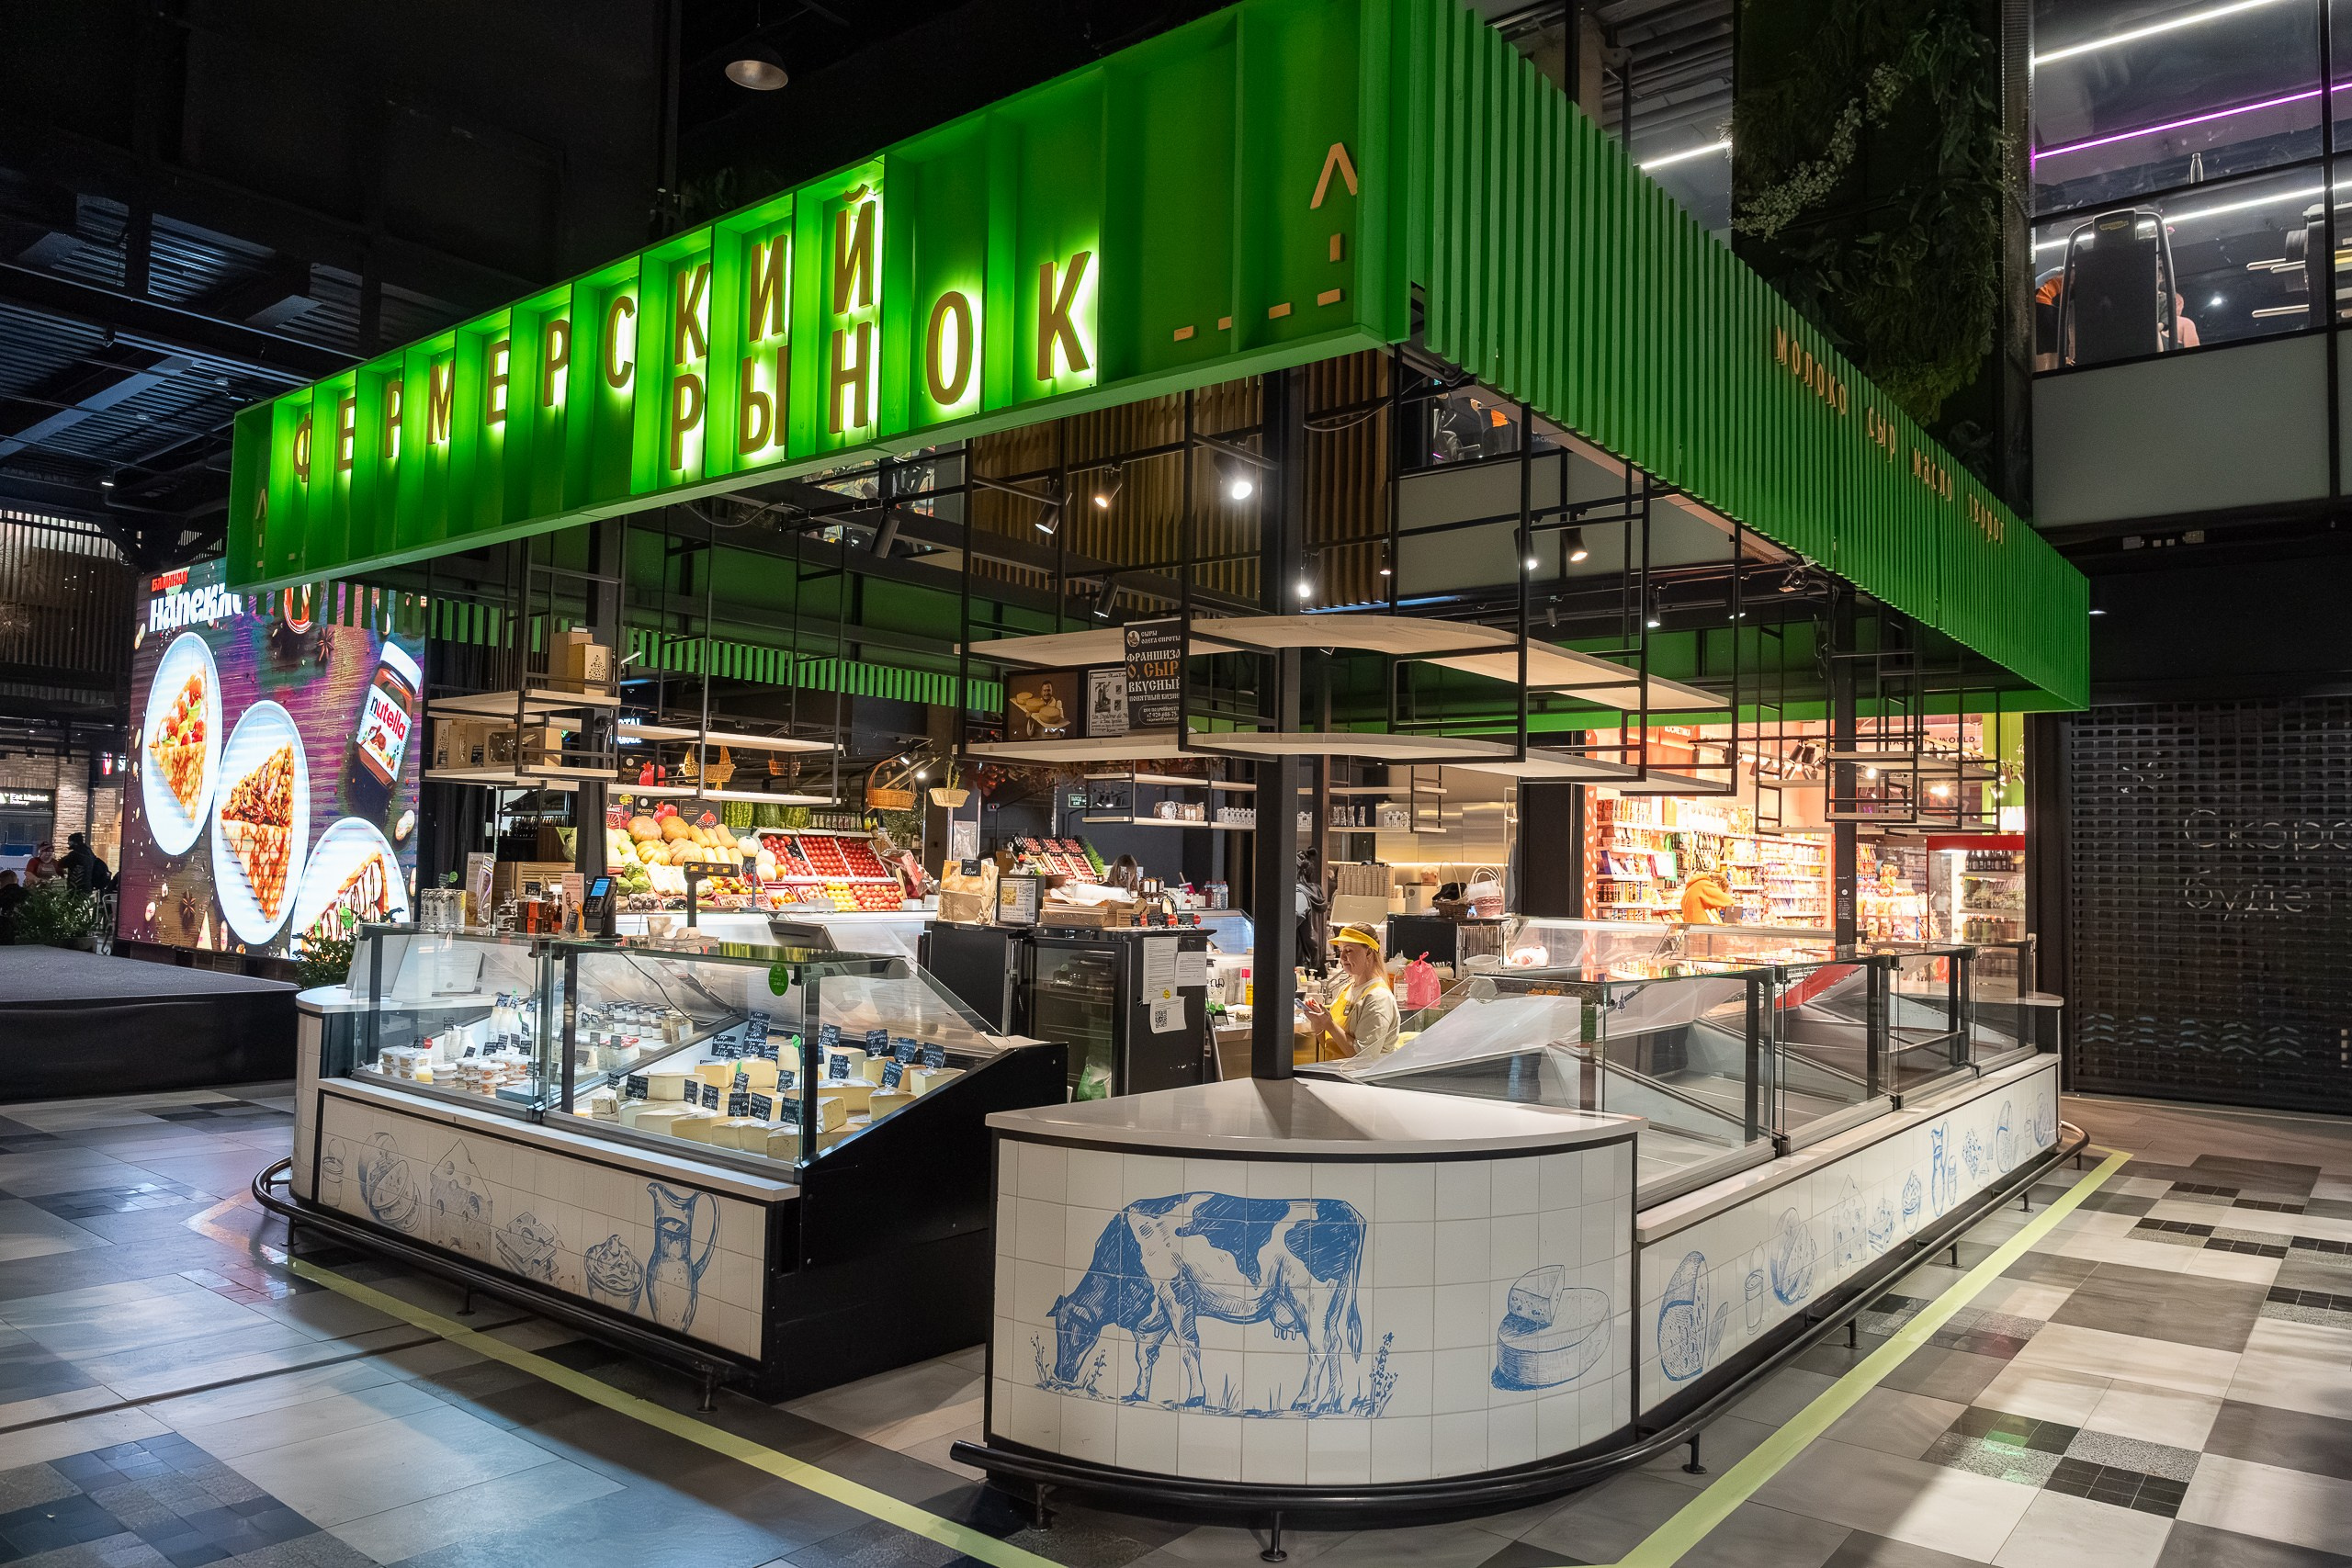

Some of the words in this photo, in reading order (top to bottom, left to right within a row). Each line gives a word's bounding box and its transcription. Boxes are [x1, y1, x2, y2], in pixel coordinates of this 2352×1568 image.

[293, 184, 876, 483] ФЕРМЕРСКИЙ
[670, 250, 1091, 470] РЫНОК
[1913, 447, 1952, 502] масло
[369, 696, 406, 741] nutella
[1938, 736, 1975, 744] WOLD
